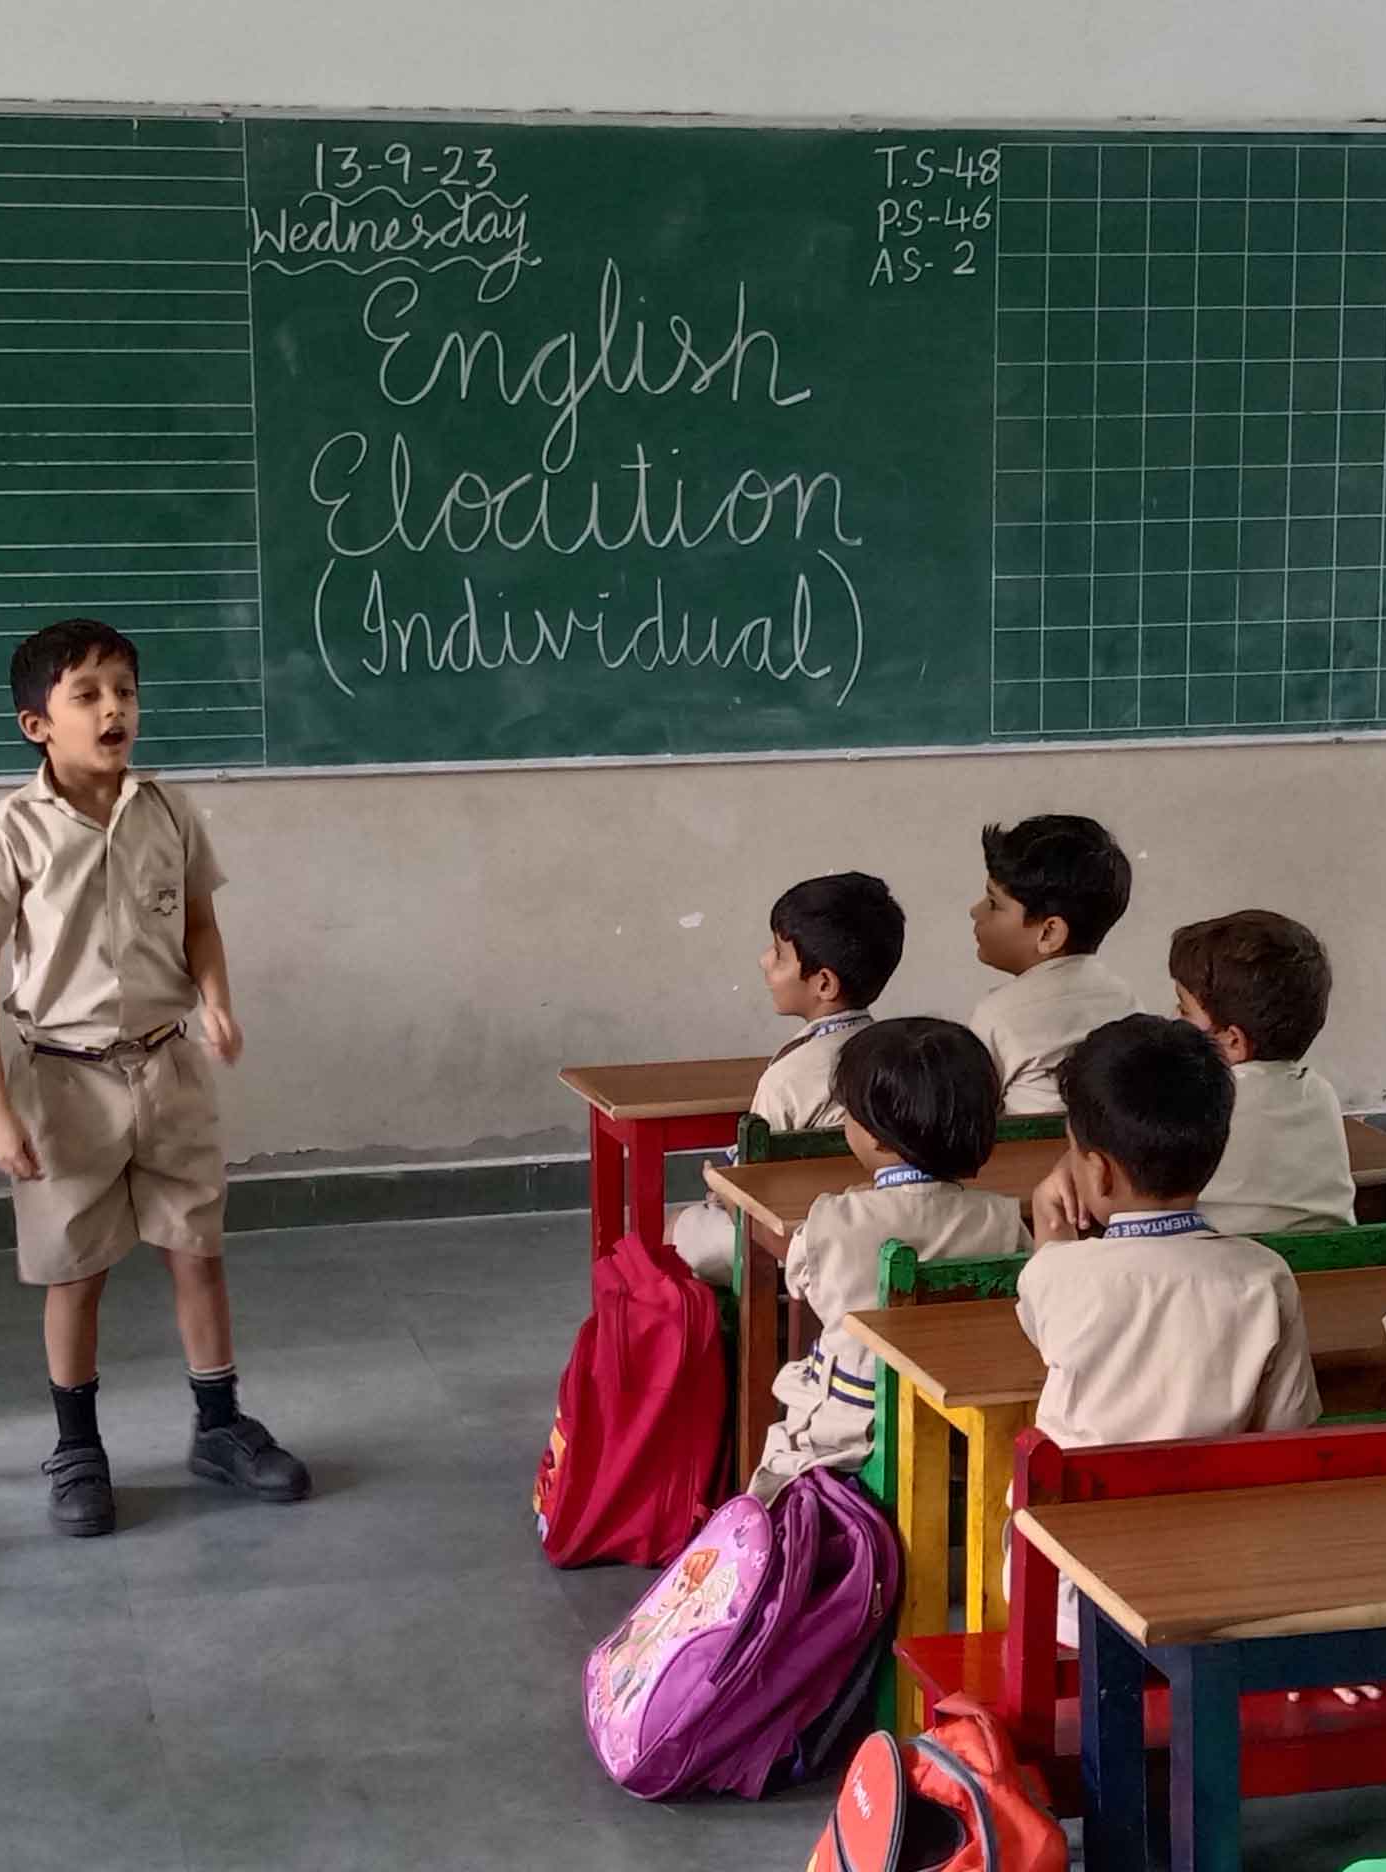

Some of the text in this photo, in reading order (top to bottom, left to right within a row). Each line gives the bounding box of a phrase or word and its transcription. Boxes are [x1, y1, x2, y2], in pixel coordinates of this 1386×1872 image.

[315, 142, 498, 191] 13-9-23
[874, 145, 1001, 190] T.S-48
[252, 192, 530, 303] Wednesday
[877, 194, 992, 243] P.S-46
[363, 257, 812, 474] English
[309, 431, 863, 557] Elocution
[314, 549, 864, 706] (Individual)
[1122, 1215, 1192, 1237] HERITAGE
